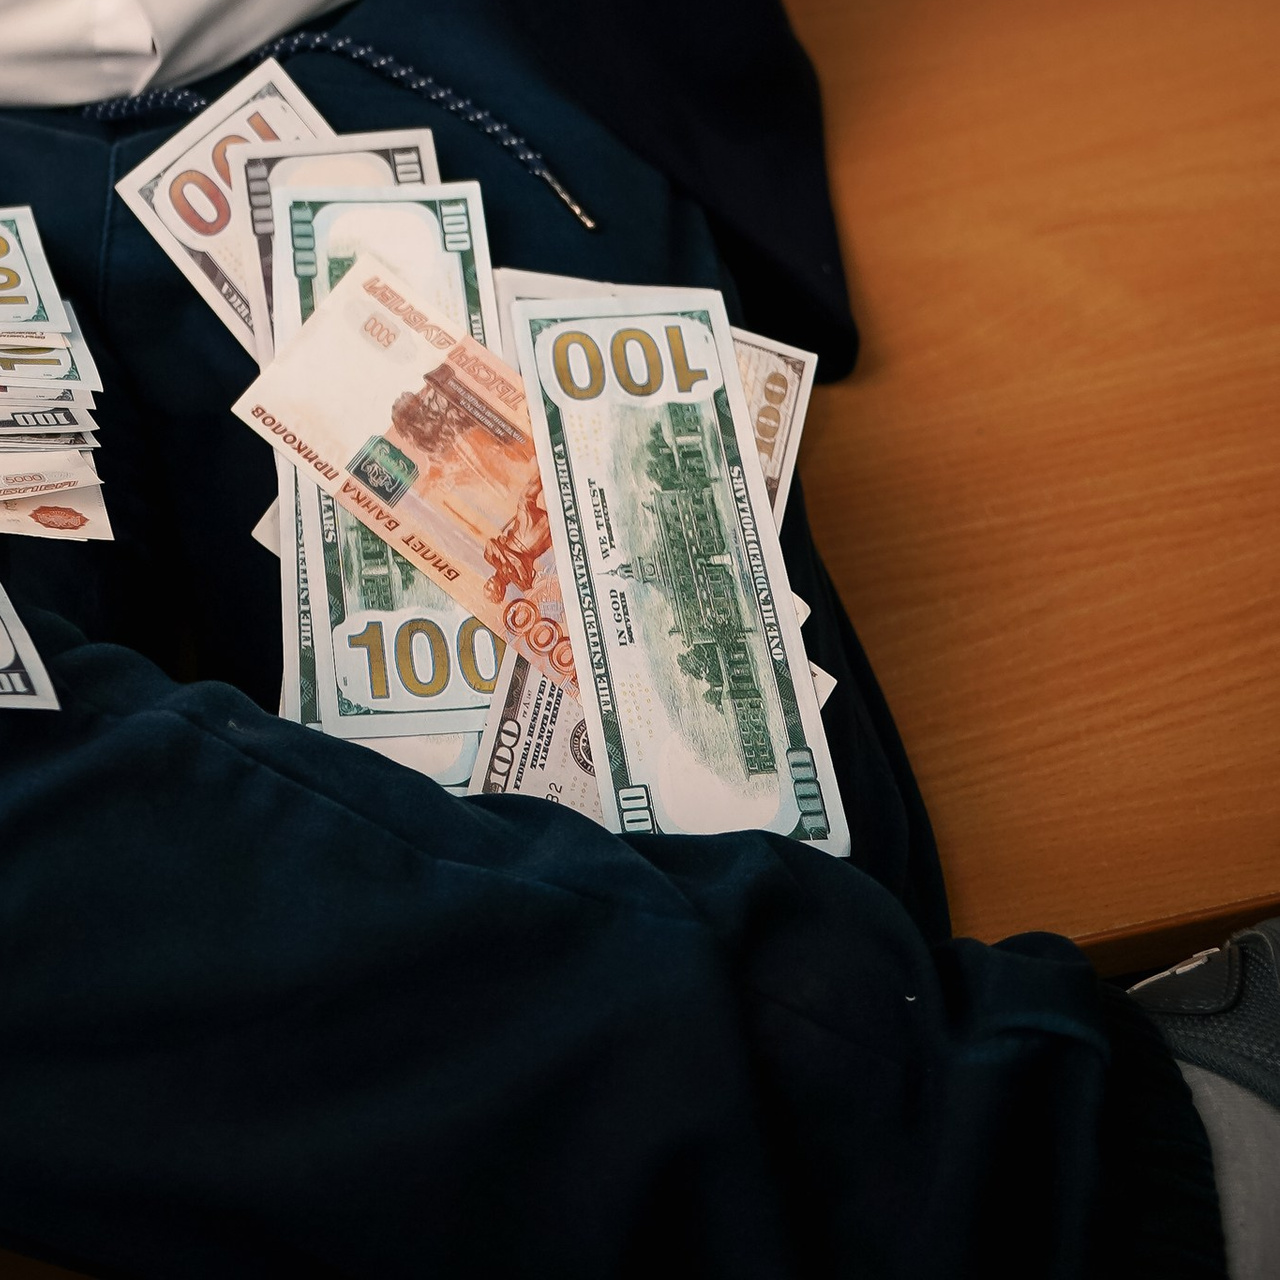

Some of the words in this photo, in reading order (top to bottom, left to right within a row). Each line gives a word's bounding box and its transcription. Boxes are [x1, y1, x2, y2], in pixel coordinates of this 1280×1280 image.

[364, 316, 396, 348] 5000
[552, 325, 708, 401] 100
[14, 412, 71, 426] 100
[251, 403, 340, 482] ПРИКОЛОВ
[756, 371, 788, 463] 100
[5, 474, 42, 484] 5000
[587, 478, 604, 531] TRUST
[342, 479, 400, 532] БАНКА
[401, 533, 461, 582] БИЛЕТ
[599, 535, 611, 560] WE
[609, 589, 623, 623] GOD
[347, 617, 506, 700] 100
[616, 628, 628, 647] IN
[489, 719, 521, 793] 100
[513, 739, 532, 791] FEDERAL
